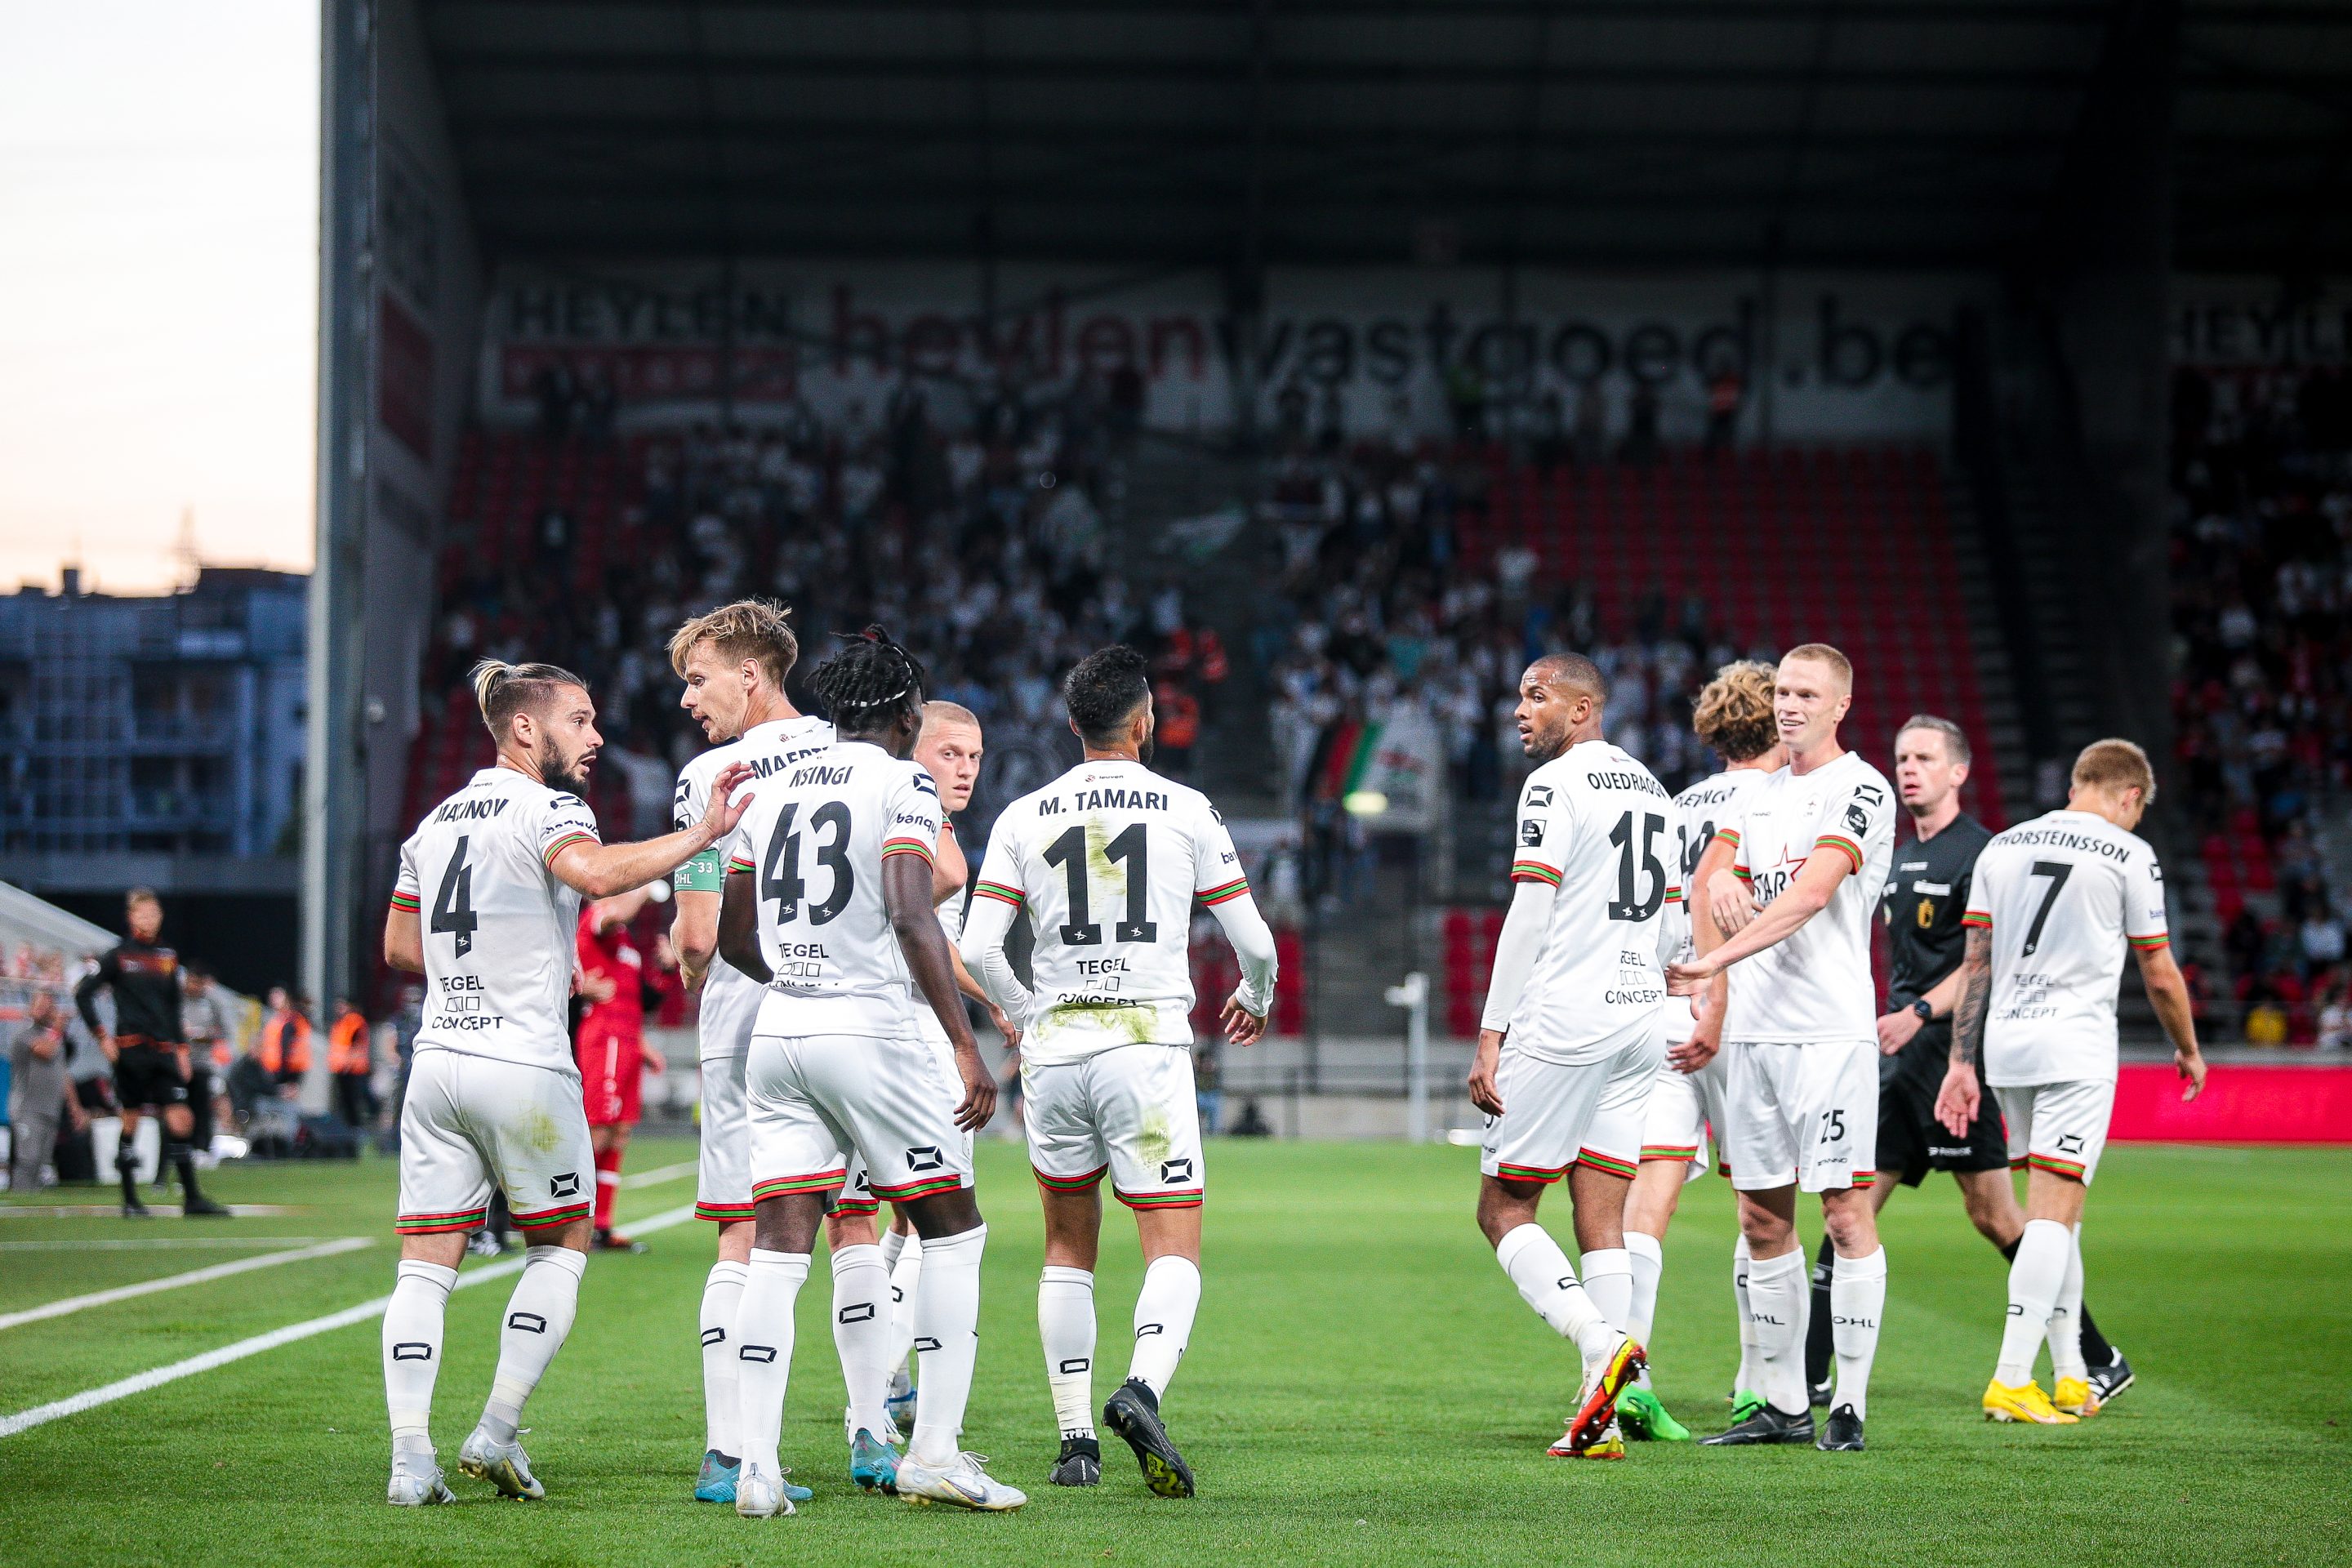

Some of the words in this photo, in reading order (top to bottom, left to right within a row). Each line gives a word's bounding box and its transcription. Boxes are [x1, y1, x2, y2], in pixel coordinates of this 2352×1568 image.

[1039, 797, 1067, 816] M.
[1076, 788, 1169, 811] TAMARI
[697, 862, 713, 874] 33
[762, 801, 855, 926] 43
[1042, 822, 1157, 946] 11
[1608, 810, 1666, 923] 15
[430, 835, 478, 960] 4
[2021, 860, 2074, 959] 7
[1076, 956, 1131, 975] TEGEL
[1605, 990, 1665, 1004] CONCEPT
[1833, 1315, 1875, 1328] OHL
